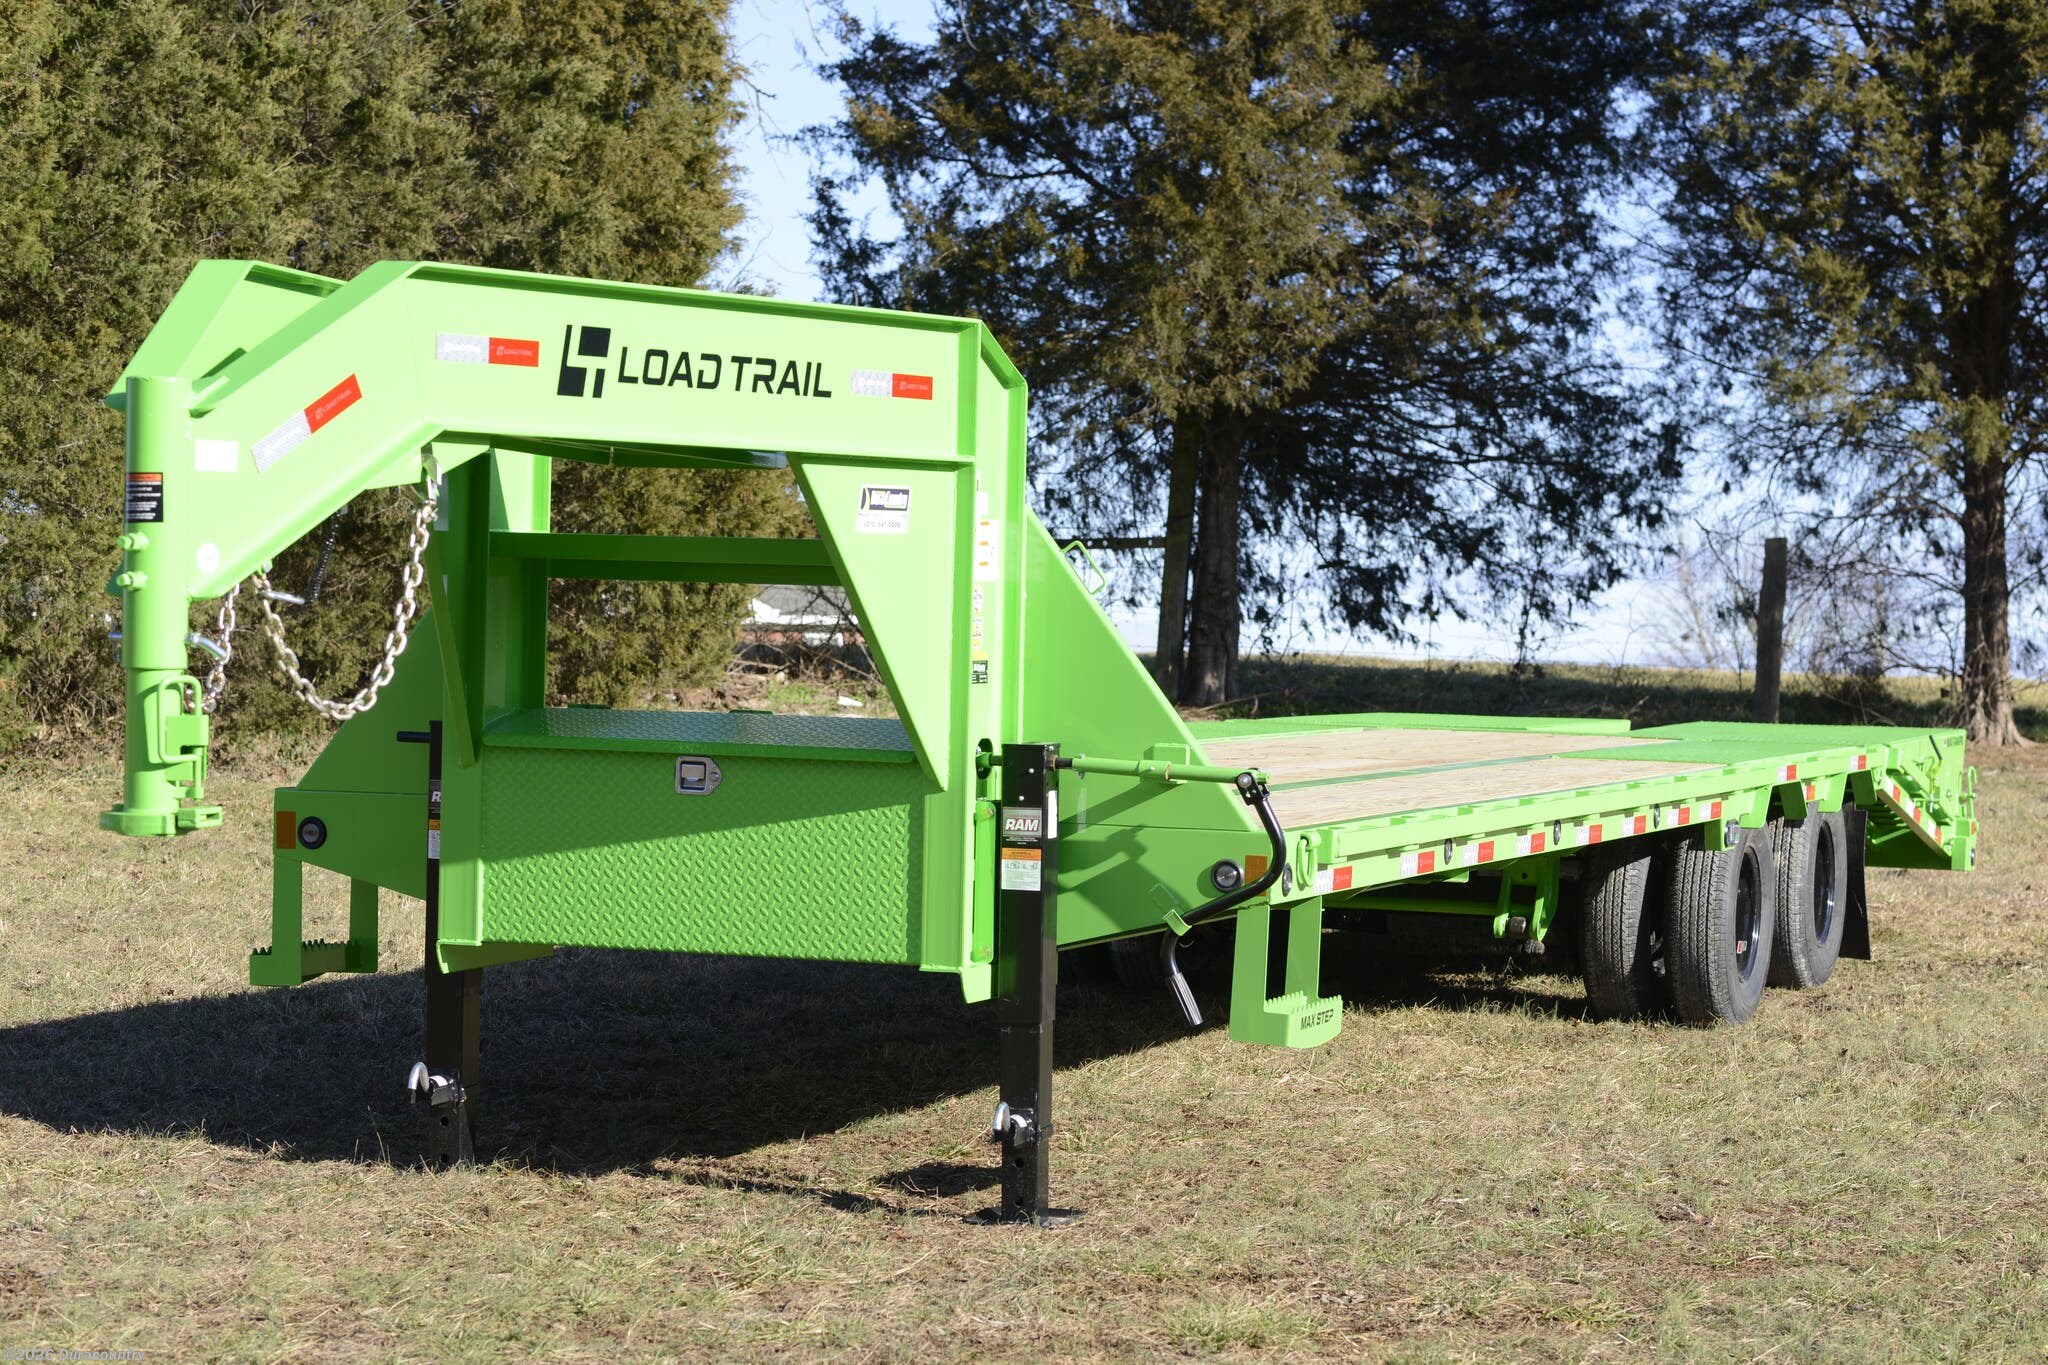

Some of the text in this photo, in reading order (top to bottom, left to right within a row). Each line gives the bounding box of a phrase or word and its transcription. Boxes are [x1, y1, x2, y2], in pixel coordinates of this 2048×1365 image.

[618, 346, 832, 398] LOAD TRAIL
[1005, 818, 1039, 832] RAM
[1300, 1009, 1334, 1031] MAX STEP
